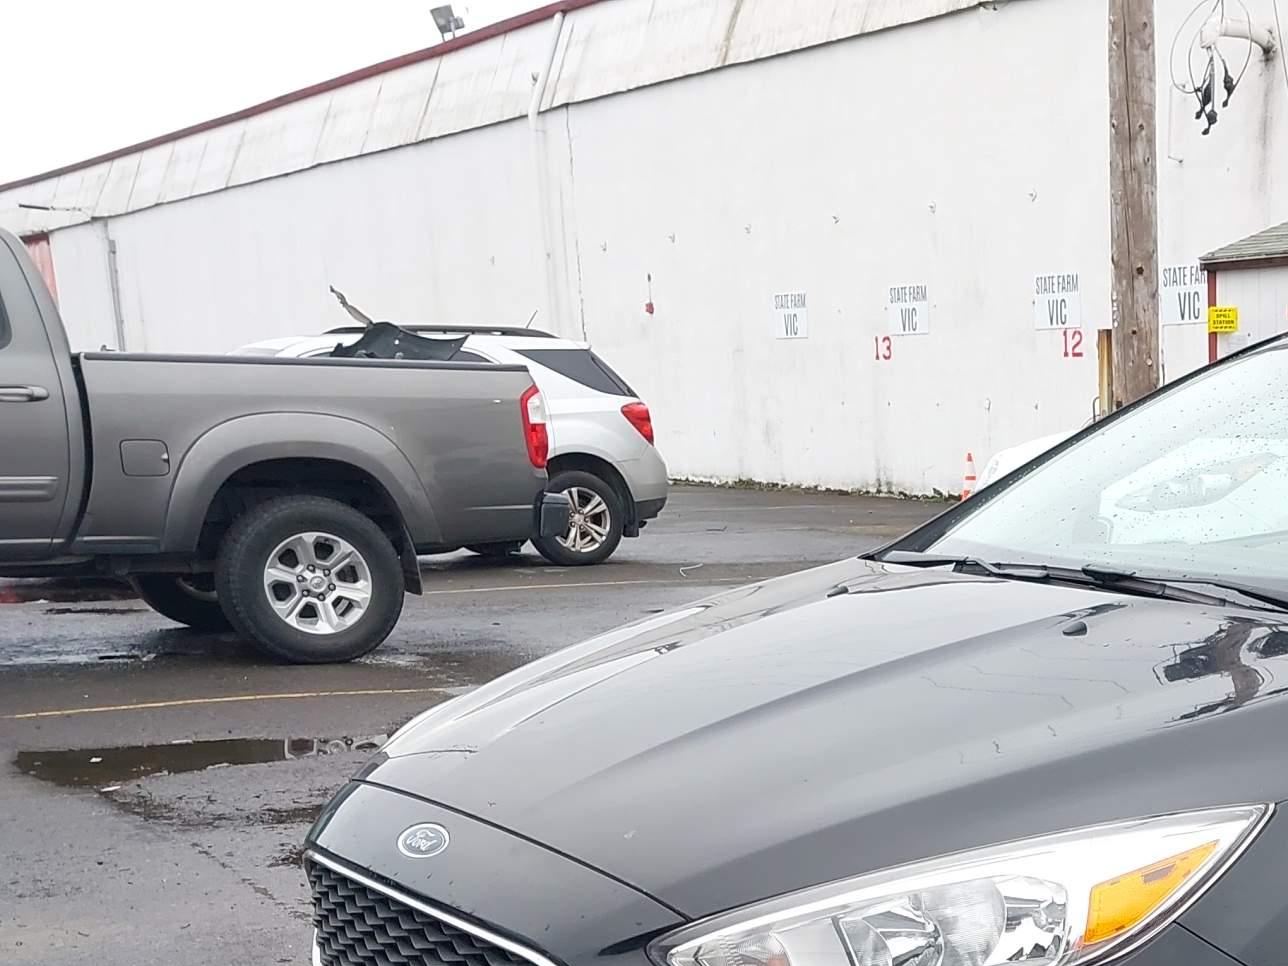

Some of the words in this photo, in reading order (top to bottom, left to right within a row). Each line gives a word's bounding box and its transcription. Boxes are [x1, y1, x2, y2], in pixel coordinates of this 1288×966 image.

[1035, 275, 1056, 295] STATE
[1057, 273, 1079, 293] FARM
[1162, 266, 1188, 288] STATE
[1190, 265, 1206, 285] FAR
[774, 293, 790, 310] STATE
[790, 292, 806, 309] FARM
[889, 286, 907, 304] STATE
[909, 285, 927, 303] FARM
[1178, 290, 1200, 321] VIC
[900, 307, 918, 332] VIC
[1048, 298, 1067, 326] VIC
[783, 313, 799, 336] VIC
[875, 335, 892, 361] 13
[1063, 329, 1084, 357] 12
